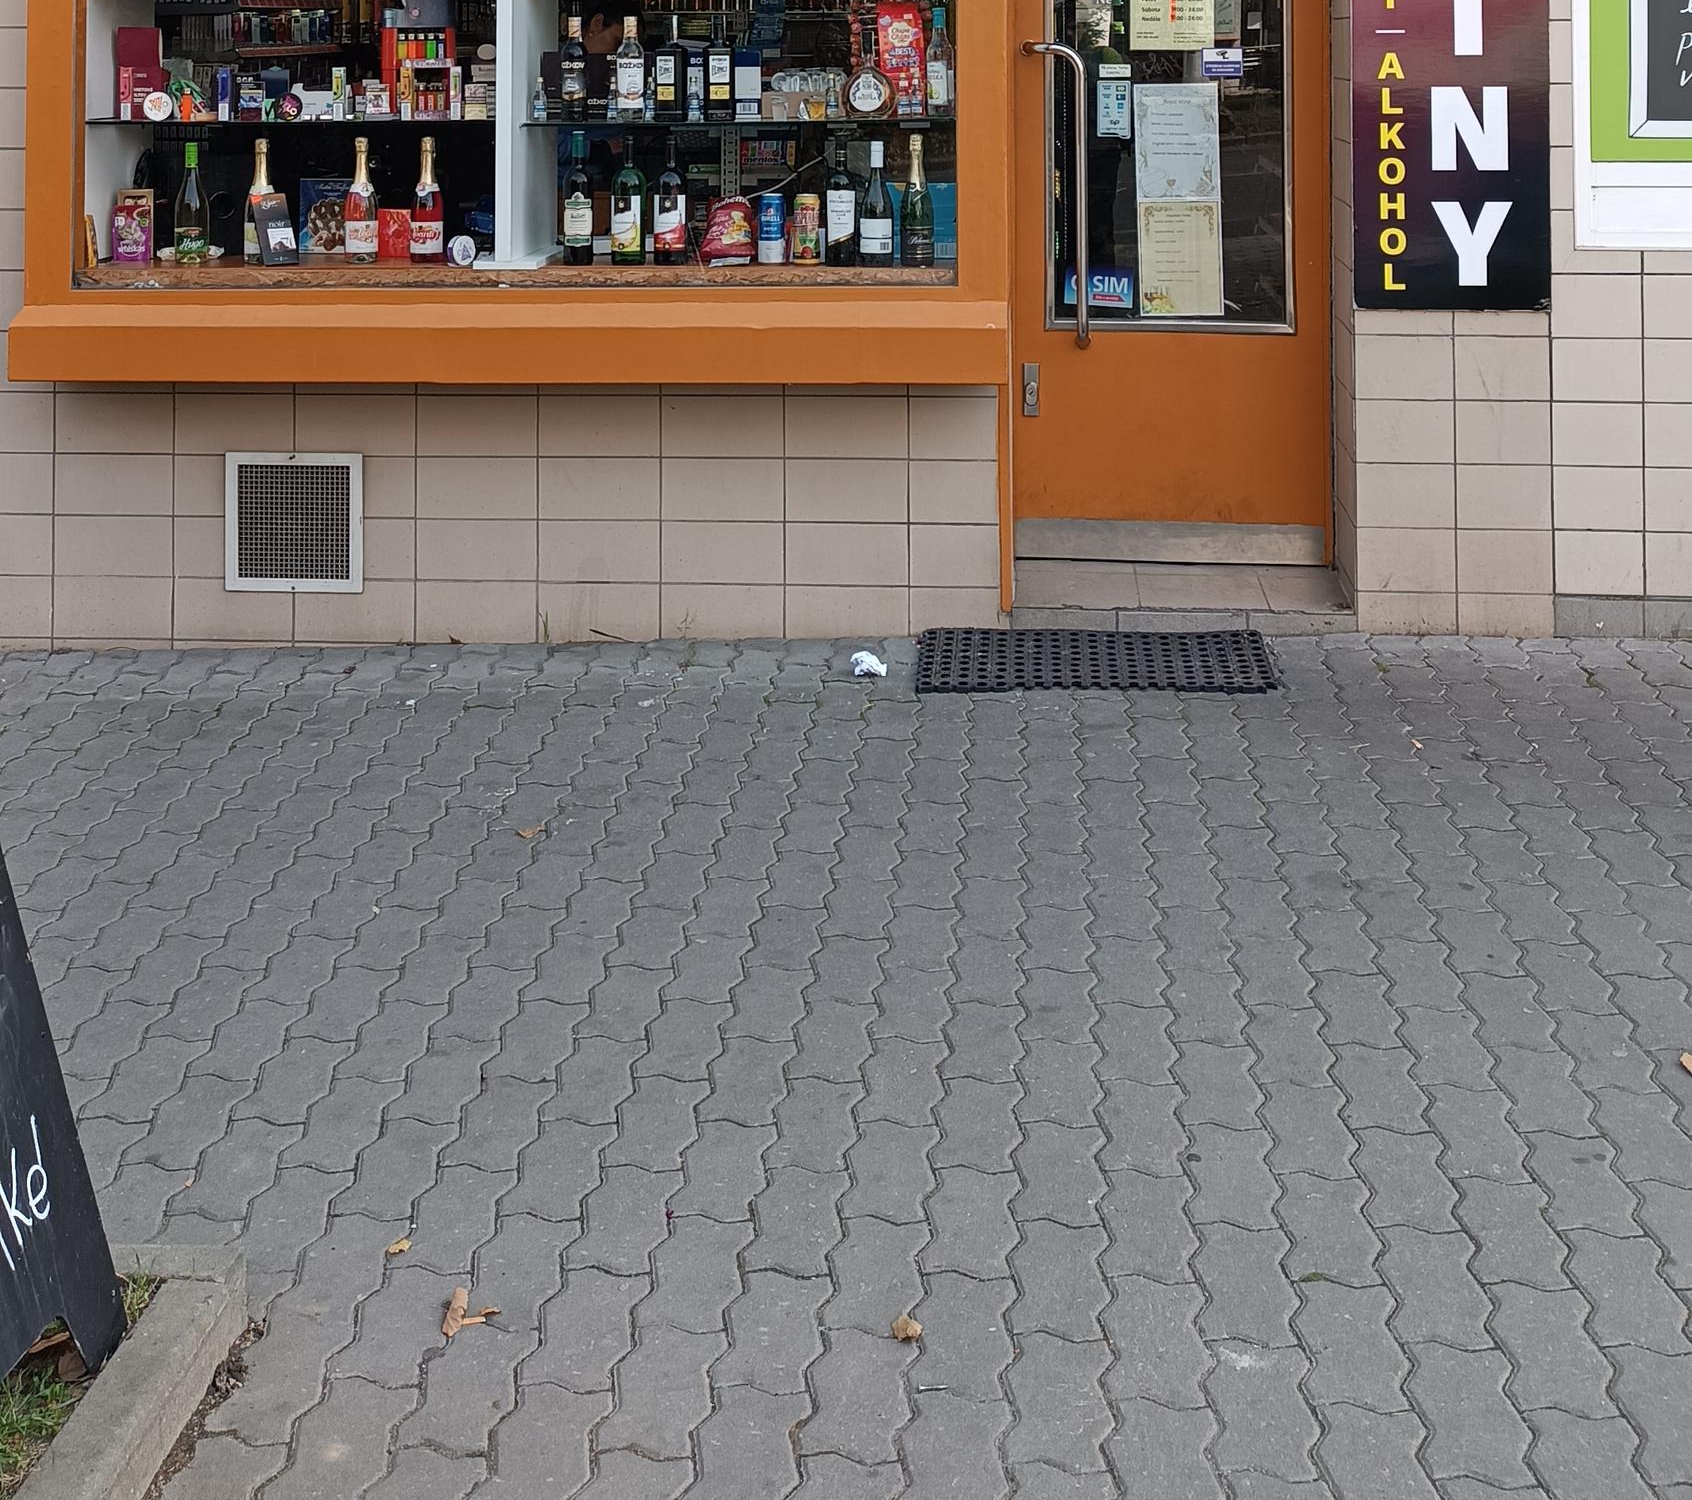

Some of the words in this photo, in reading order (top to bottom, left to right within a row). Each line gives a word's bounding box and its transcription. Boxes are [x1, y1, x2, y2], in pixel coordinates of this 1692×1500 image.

[742, 155, 778, 164] mentos
[1377, 52, 1407, 291] ALKOHOL
[268, 220, 285, 228] noir
[181, 238, 205, 250] Hugo
[1092, 275, 1129, 294] SIM
